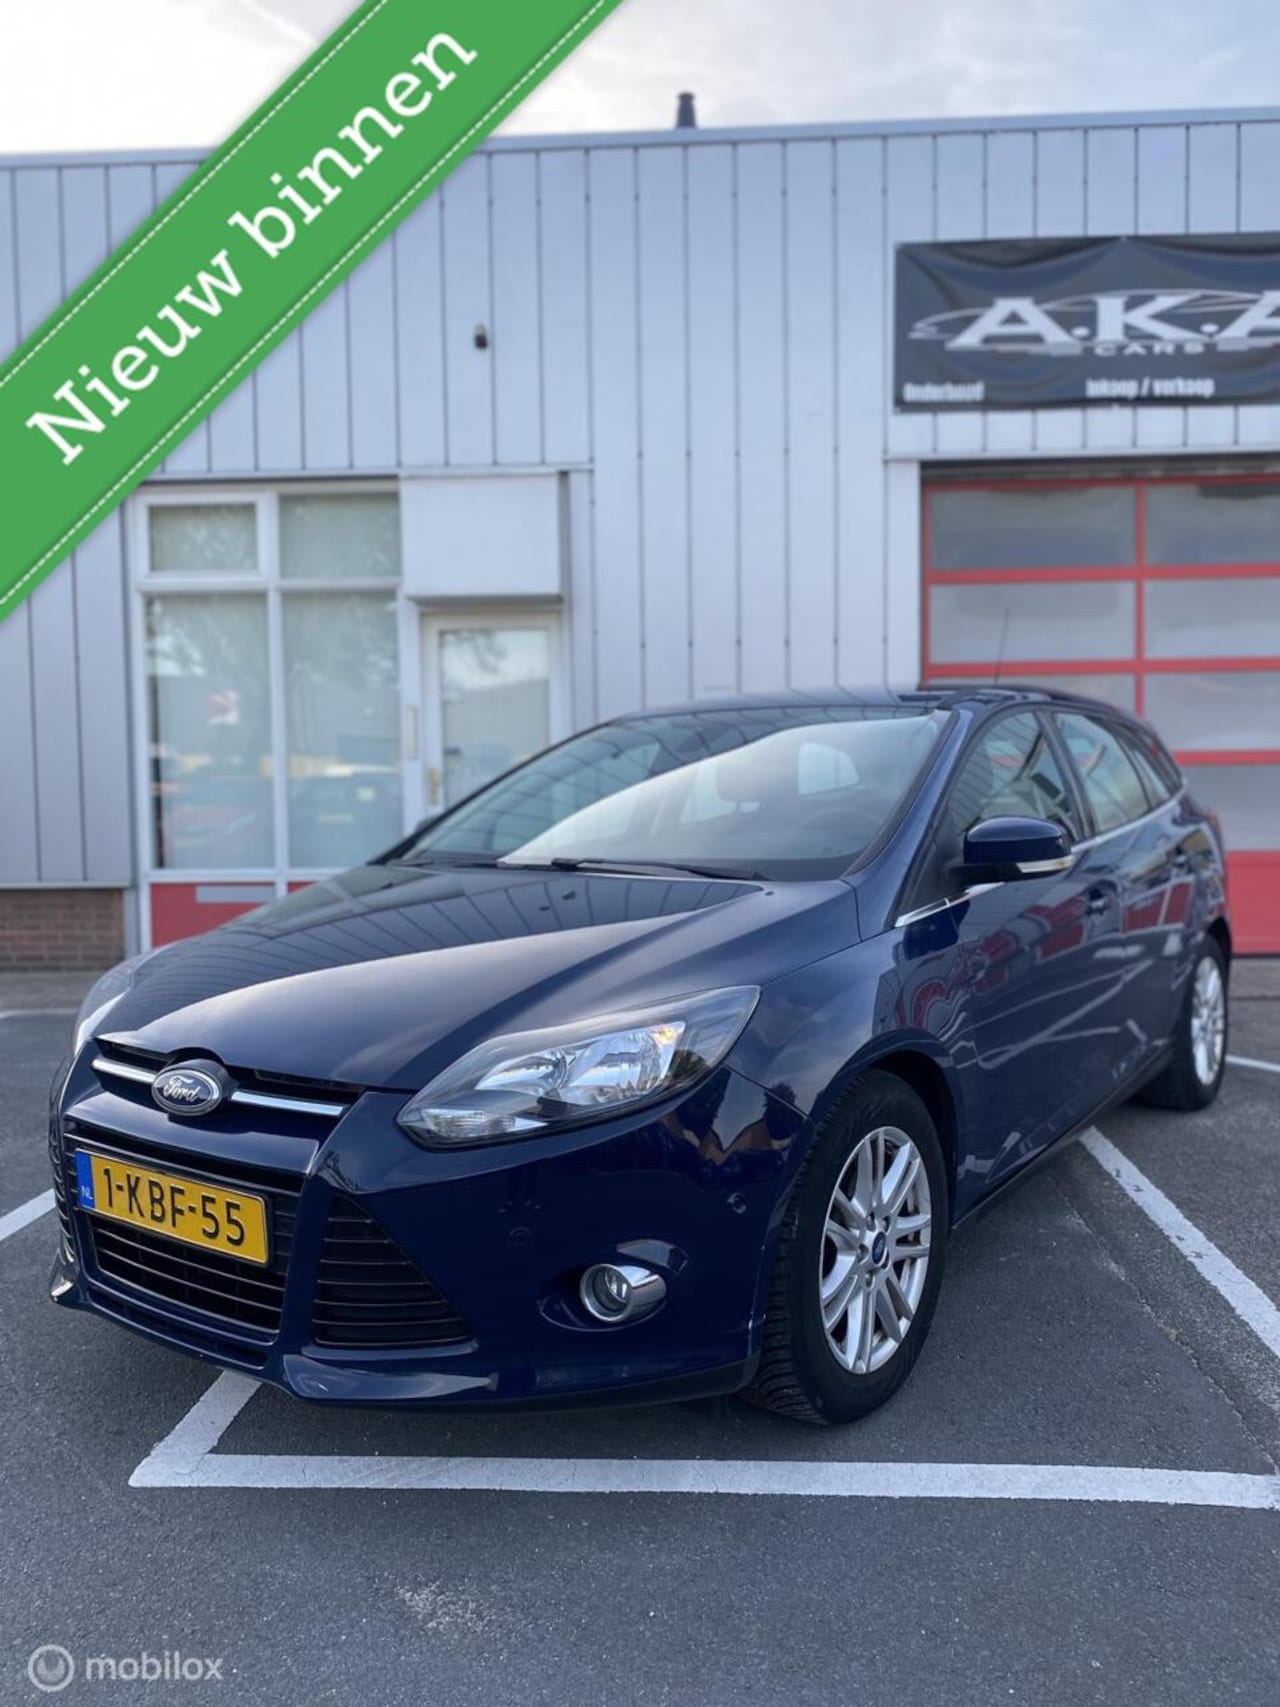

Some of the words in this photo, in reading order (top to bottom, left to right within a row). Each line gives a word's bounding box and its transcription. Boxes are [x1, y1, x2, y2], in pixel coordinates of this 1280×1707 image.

[163, 1075, 201, 1102] Ford
[81, 1185, 93, 1200] NL
[103, 1168, 245, 1246] 1-KBF-55
